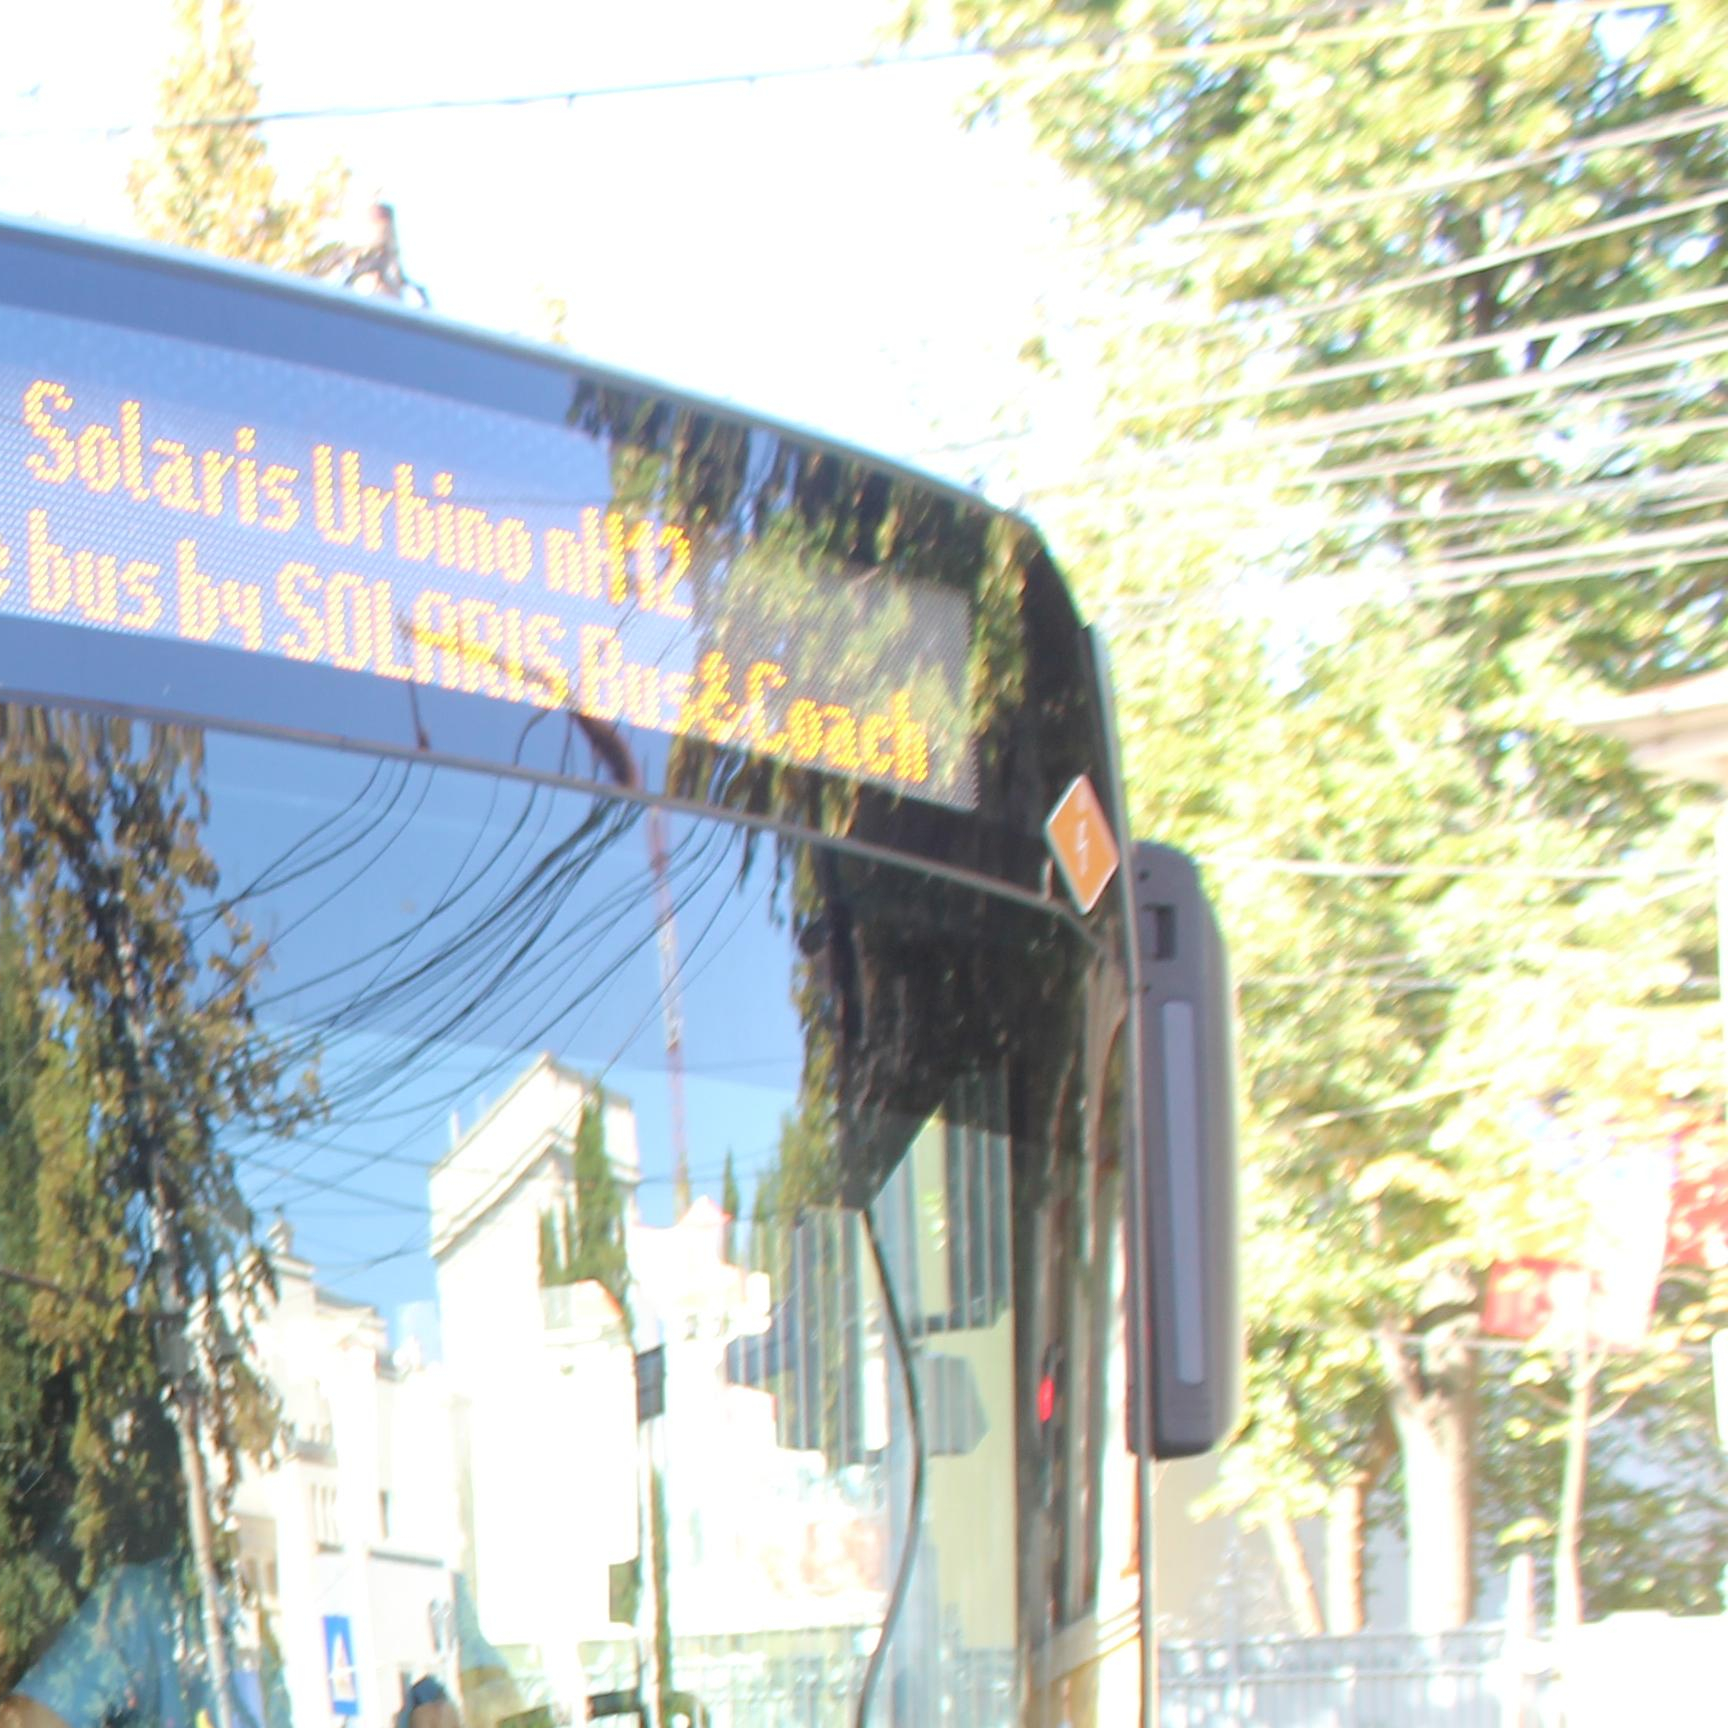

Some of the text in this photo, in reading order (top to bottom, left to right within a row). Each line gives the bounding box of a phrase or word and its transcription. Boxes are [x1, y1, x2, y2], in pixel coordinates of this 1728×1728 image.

[23, 379, 694, 621] Solaris Urbino nH12
[27, 507, 165, 631] bus
[176, 537, 265, 652] by
[275, 560, 570, 711] SOLARIS
